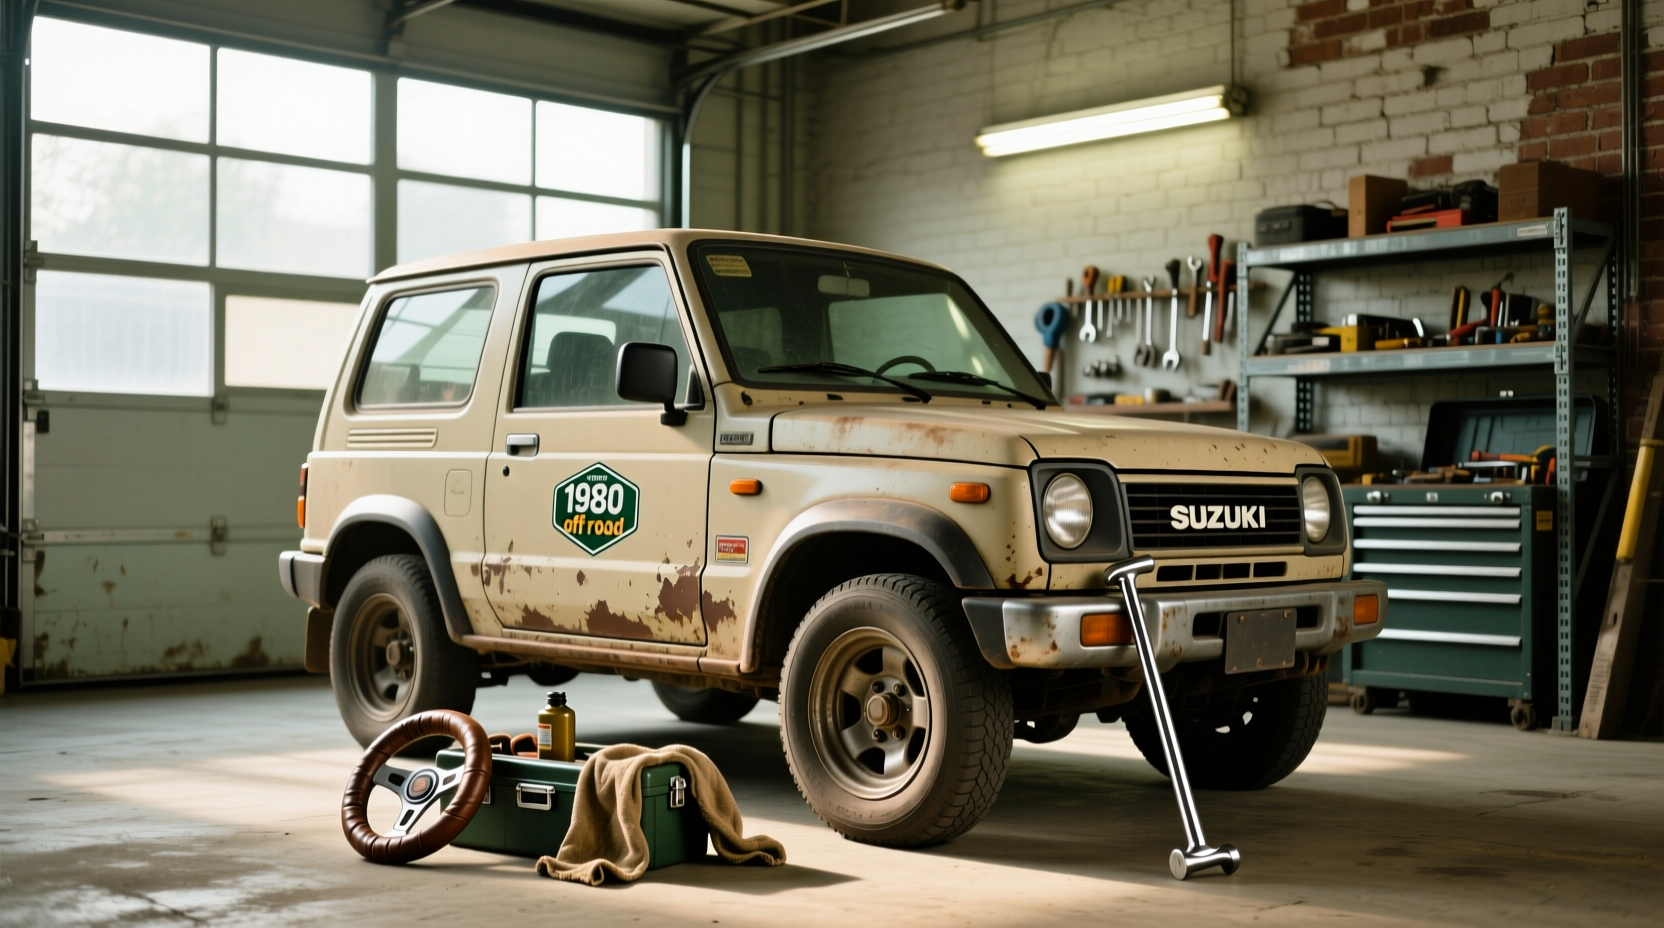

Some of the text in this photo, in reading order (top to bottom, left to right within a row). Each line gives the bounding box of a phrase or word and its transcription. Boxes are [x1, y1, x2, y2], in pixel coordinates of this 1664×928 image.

[564, 482, 624, 515] 1980
[563, 513, 625, 536] off road
[1170, 504, 1266, 530] SUZUKI
